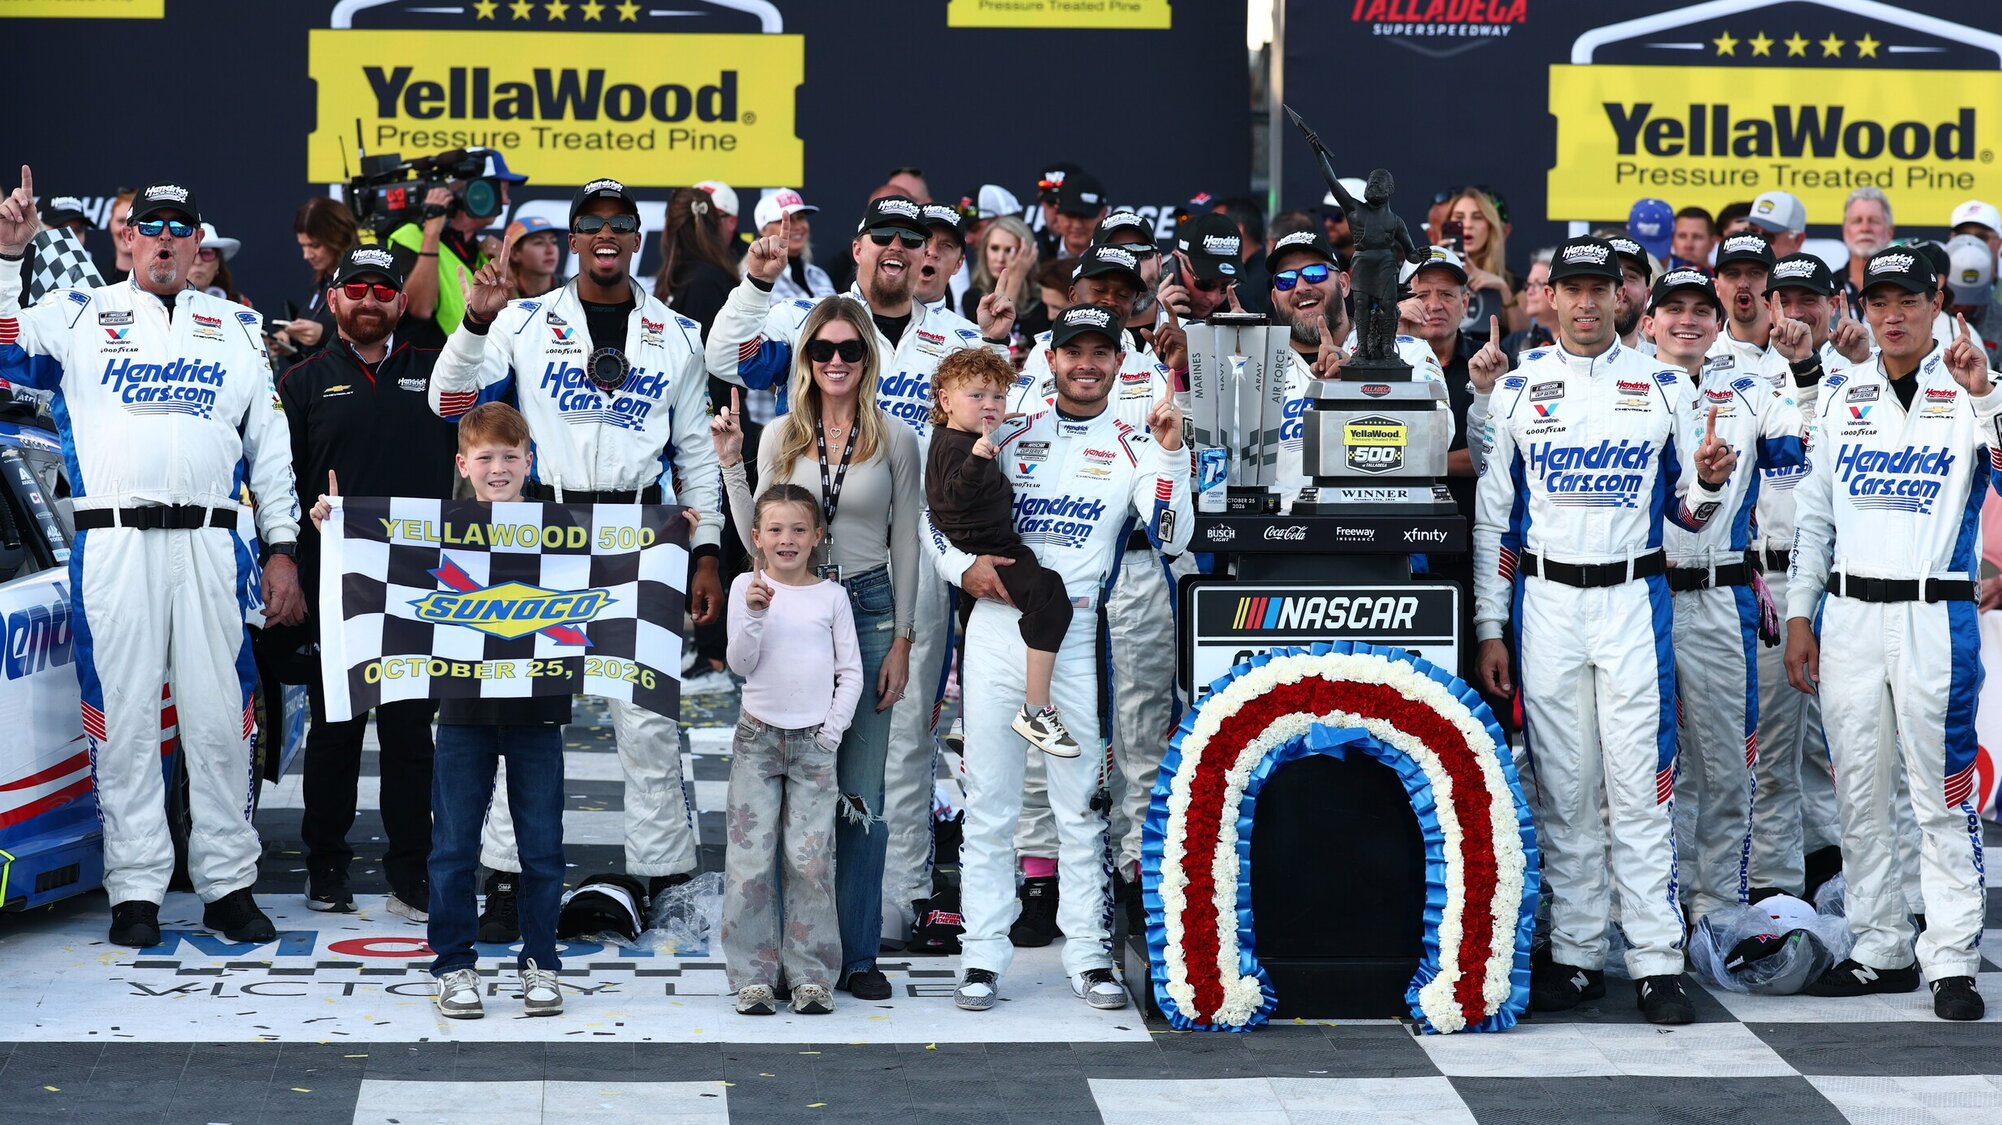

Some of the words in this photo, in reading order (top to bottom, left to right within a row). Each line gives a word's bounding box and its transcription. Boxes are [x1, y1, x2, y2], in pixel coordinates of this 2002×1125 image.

[978, 0, 1044, 12] Pressure
[1049, 0, 1105, 12] Treated
[1109, 0, 1141, 12] Pine
[1352, 0, 1527, 23] TALLADEGA
[1372, 23, 1511, 37] SUPERSPEEDWAY
[376, 125, 521, 149] Pressure
[531, 127, 656, 151] Treated
[668, 128, 738, 152] Pine
[1616, 162, 1760, 187] Pressure
[1770, 164, 1894, 189] Treated
[1907, 166, 1975, 190] Pine
[145, 184, 188, 198] Hendrick
[878, 199, 920, 214] Hendrick
[1723, 235, 1766, 250] Hendrick
[351, 249, 394, 264] Hendrick
[1096, 247, 1137, 264] Hendrick
[1563, 244, 1609, 259] Hendrick
[1773, 259, 1817, 273] Hendrick
[1869, 253, 1914, 269] Hendrick
[1664, 271, 1708, 283] Hendrick
[192, 312, 223, 325] Hendrick
[1064, 308, 1110, 322] Hendrick
[1274, 349, 1286, 383] FORCE
[101, 357, 227, 393] Hendrick
[540, 361, 670, 399] Henick
[1120, 371, 1152, 381] Hendrick
[1195, 352, 1203, 399] MARINES
[1255, 361, 1263, 392] ARMY
[1616, 379, 1651, 391] Hendrick
[122, 383, 217, 406] Cars.com
[1271, 385, 1281, 404] AIR
[1925, 387, 1957, 400] Hendrick
[1350, 429, 1401, 438] YellaWood
[1525, 425, 1567, 435] GOODYEAR
[1082, 447, 1117, 460] Hendrick
[1354, 446, 1396, 464] 500
[1530, 439, 1655, 480] Hendrick
[1835, 443, 1956, 482] Hendrick
[1010, 481, 1041, 489] OODYEAR
[1546, 471, 1644, 493] Cars.com
[1849, 473, 1942, 499] Cars.com
[1342, 489, 1409, 499] WINNER
[1010, 492, 1107, 523] Hendrick
[378, 517, 588, 549] YELLAWOOD
[598, 526, 656, 550] 500
[1017, 516, 1094, 538] Cars.com
[1207, 529, 1236, 538] BUSCH
[1336, 526, 1376, 538] Freeway
[1403, 528, 1448, 543] xfinity
[425, 594, 601, 621] SUNOCO
[1277, 596, 1419, 629] NASCAR
[363, 657, 516, 685] OCTOBER
[525, 659, 574, 681] 25,
[584, 658, 657, 690] 2026
[665, 981, 957, 998] LE
